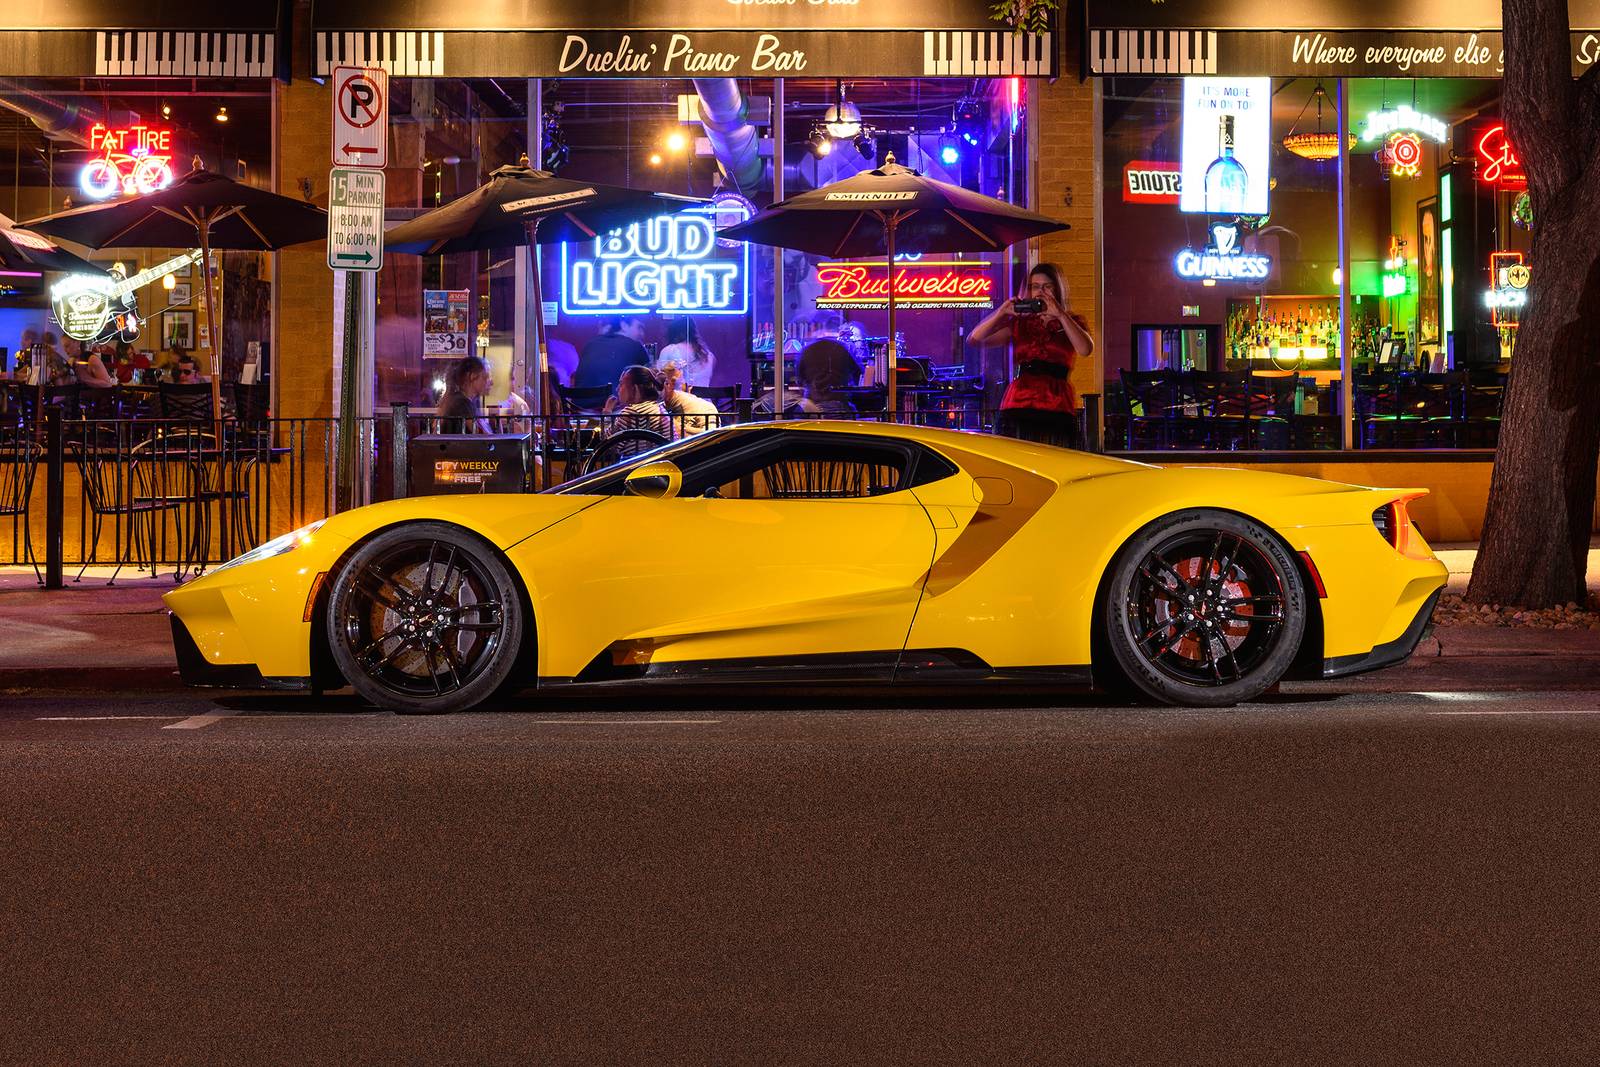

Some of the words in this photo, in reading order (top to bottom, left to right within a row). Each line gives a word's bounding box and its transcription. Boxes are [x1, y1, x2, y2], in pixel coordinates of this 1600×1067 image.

[559, 35, 657, 72] Duelin’
[664, 34, 740, 72] Piano
[751, 34, 807, 72] Bar
[1292, 34, 1357, 64] Where
[1365, 44, 1446, 71] everyone
[1454, 34, 1491, 64] else
[1224, 87, 1251, 97] MORE
[91, 125, 129, 150] FAT
[131, 126, 171, 150] TIRE
[332, 176, 347, 202] 15
[356, 175, 374, 189] MIN
[348, 190, 381, 205] PARKING
[341, 213, 358, 227] 8:00
[361, 215, 373, 228] AM
[335, 232, 344, 245] TO
[346, 233, 364, 246] 6:00
[366, 233, 377, 247] PM
[595, 215, 715, 260] BUD
[1177, 252, 1269, 278] GUINNESS
[573, 261, 738, 308] LIGHT
[817, 267, 992, 298] Budweiser
[435, 461, 459, 470] CITY
[460, 461, 499, 470] WEEKLY
[454, 475, 482, 483] FREE
